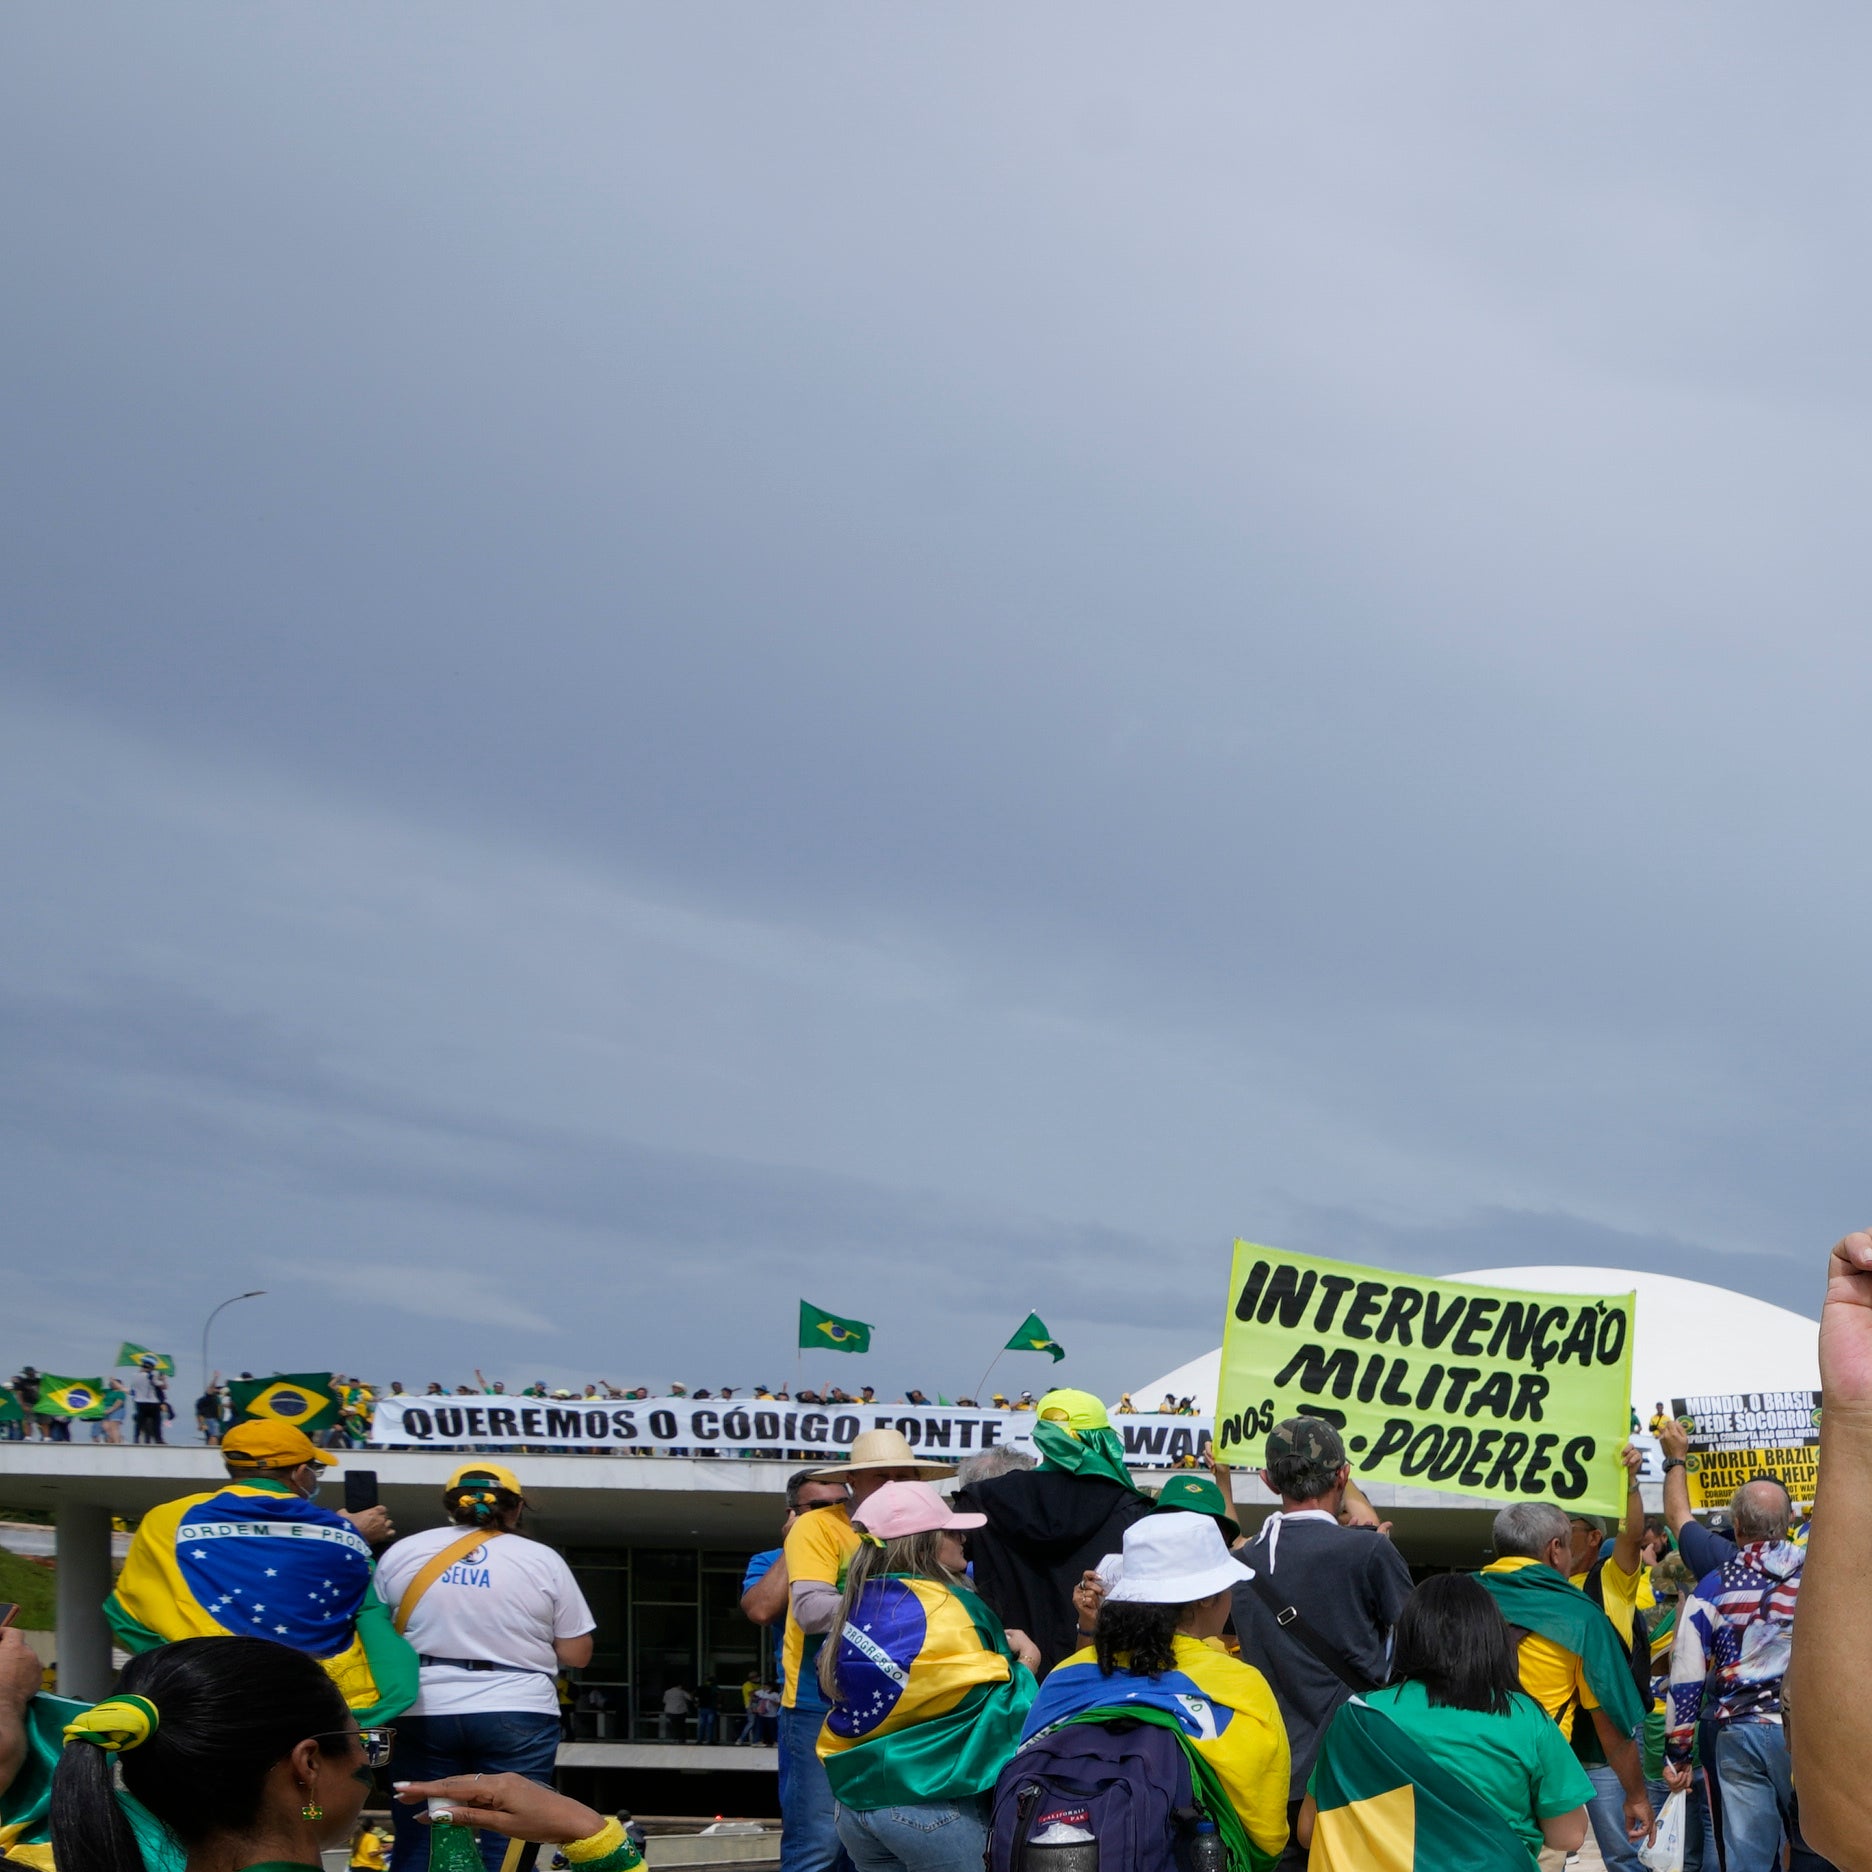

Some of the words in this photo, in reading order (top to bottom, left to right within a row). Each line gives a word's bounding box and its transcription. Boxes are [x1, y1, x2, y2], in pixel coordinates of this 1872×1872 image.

[1235, 1260, 1627, 1372] INTERVENÇÃO
[1273, 1343, 1550, 1422] MILITAR
[1685, 1395, 1748, 1416] MUNDO,
[1749, 1393, 1761, 1412] O
[1763, 1391, 1816, 1411] BRASIL
[402, 1408, 636, 1440] QUEREMOS
[650, 1409, 678, 1439] O
[691, 1405, 860, 1444] CÓDIGO
[1694, 1413, 1734, 1434] PEDE
[1735, 1409, 1812, 1432] SOCORRO!
[1220, 1398, 1275, 1449] NOS
[1359, 1418, 1596, 1500] PODERES
[1700, 1450, 1762, 1470] WORLD,
[1765, 1448, 1815, 1466] BRAZIL
[1700, 1470, 1746, 1489] CALLS
[182, 1524, 270, 1538] ORDEM
[291, 1525, 303, 1537] E
[441, 1565, 491, 1589] SELVA
[846, 1627, 903, 1680] PROGRESSO
